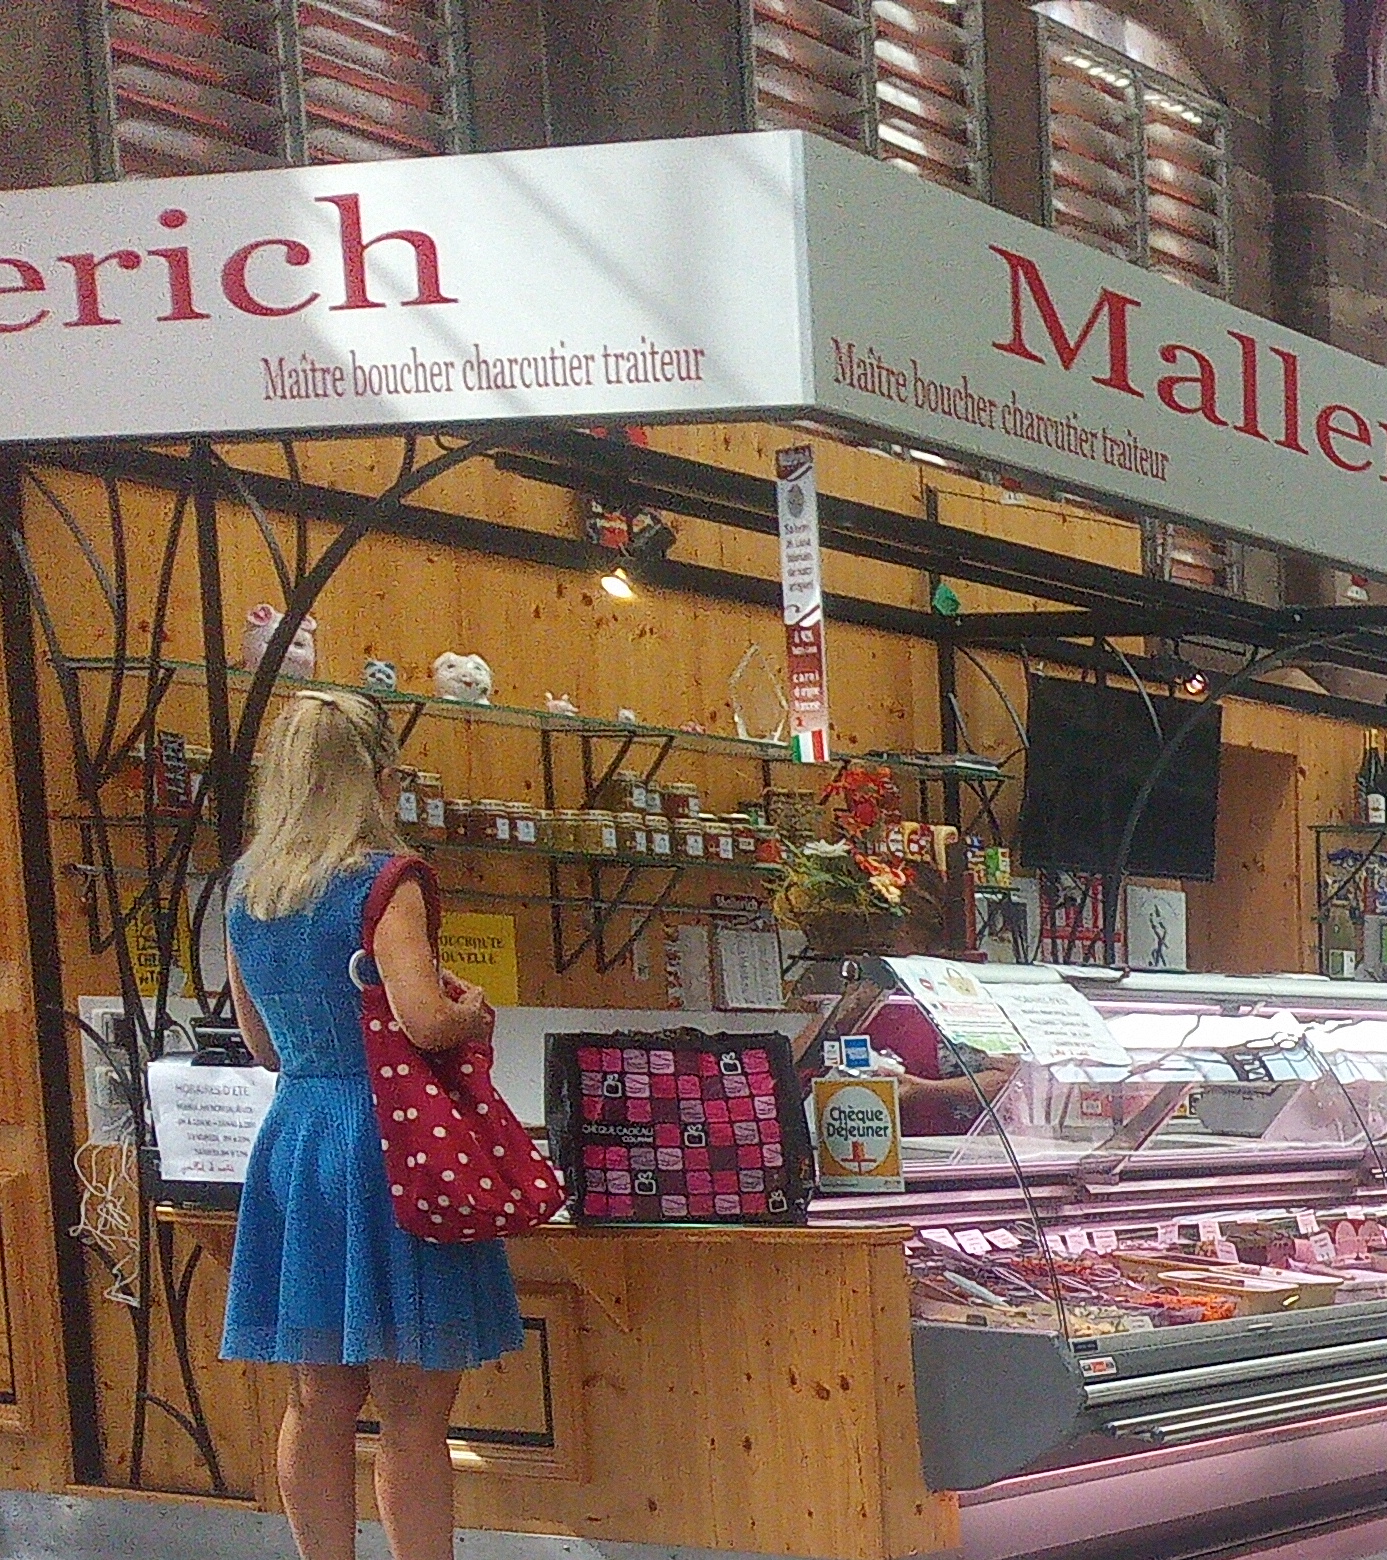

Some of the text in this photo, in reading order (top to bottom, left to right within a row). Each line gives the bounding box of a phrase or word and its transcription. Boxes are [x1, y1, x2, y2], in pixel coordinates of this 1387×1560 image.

[261, 335, 706, 401] Maître boucher charcutier traiteur
[830, 335, 1171, 483] Maître boucher charcutier traiteur
[829, 1105, 884, 1123] Chèque
